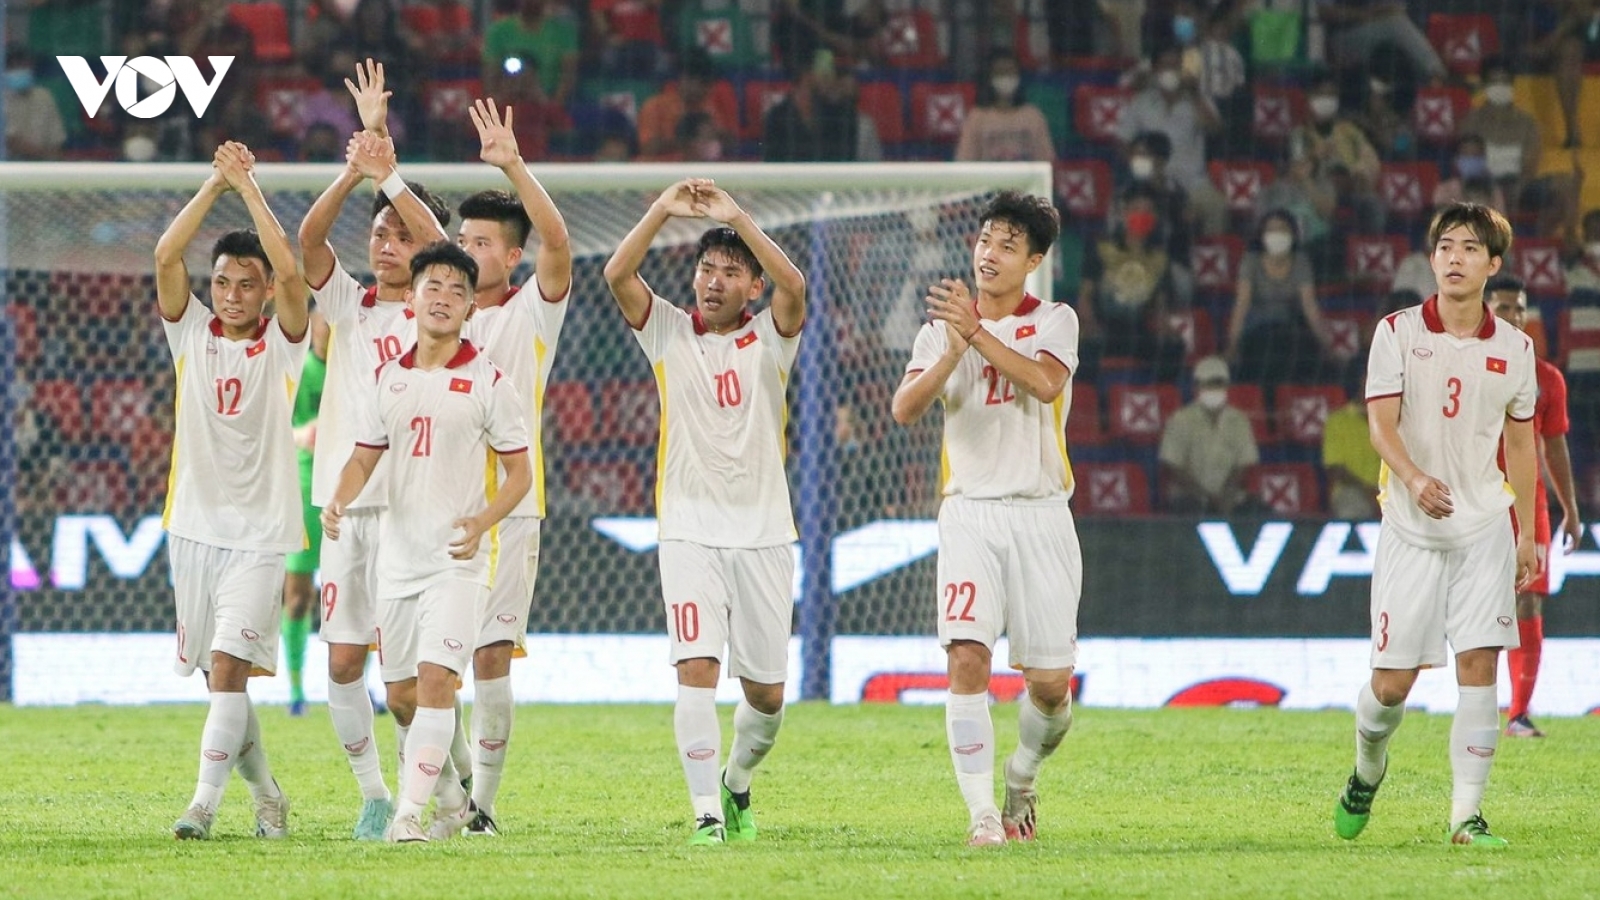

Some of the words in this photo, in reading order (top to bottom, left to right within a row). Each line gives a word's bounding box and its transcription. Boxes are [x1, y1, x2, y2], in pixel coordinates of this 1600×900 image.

[215, 377, 242, 415] 12
[714, 368, 741, 408] 10
[1442, 377, 1462, 418] 3
[411, 416, 431, 457] 21
[944, 581, 976, 622] 22
[672, 602, 699, 643] 10
[1376, 611, 1389, 652] 3
